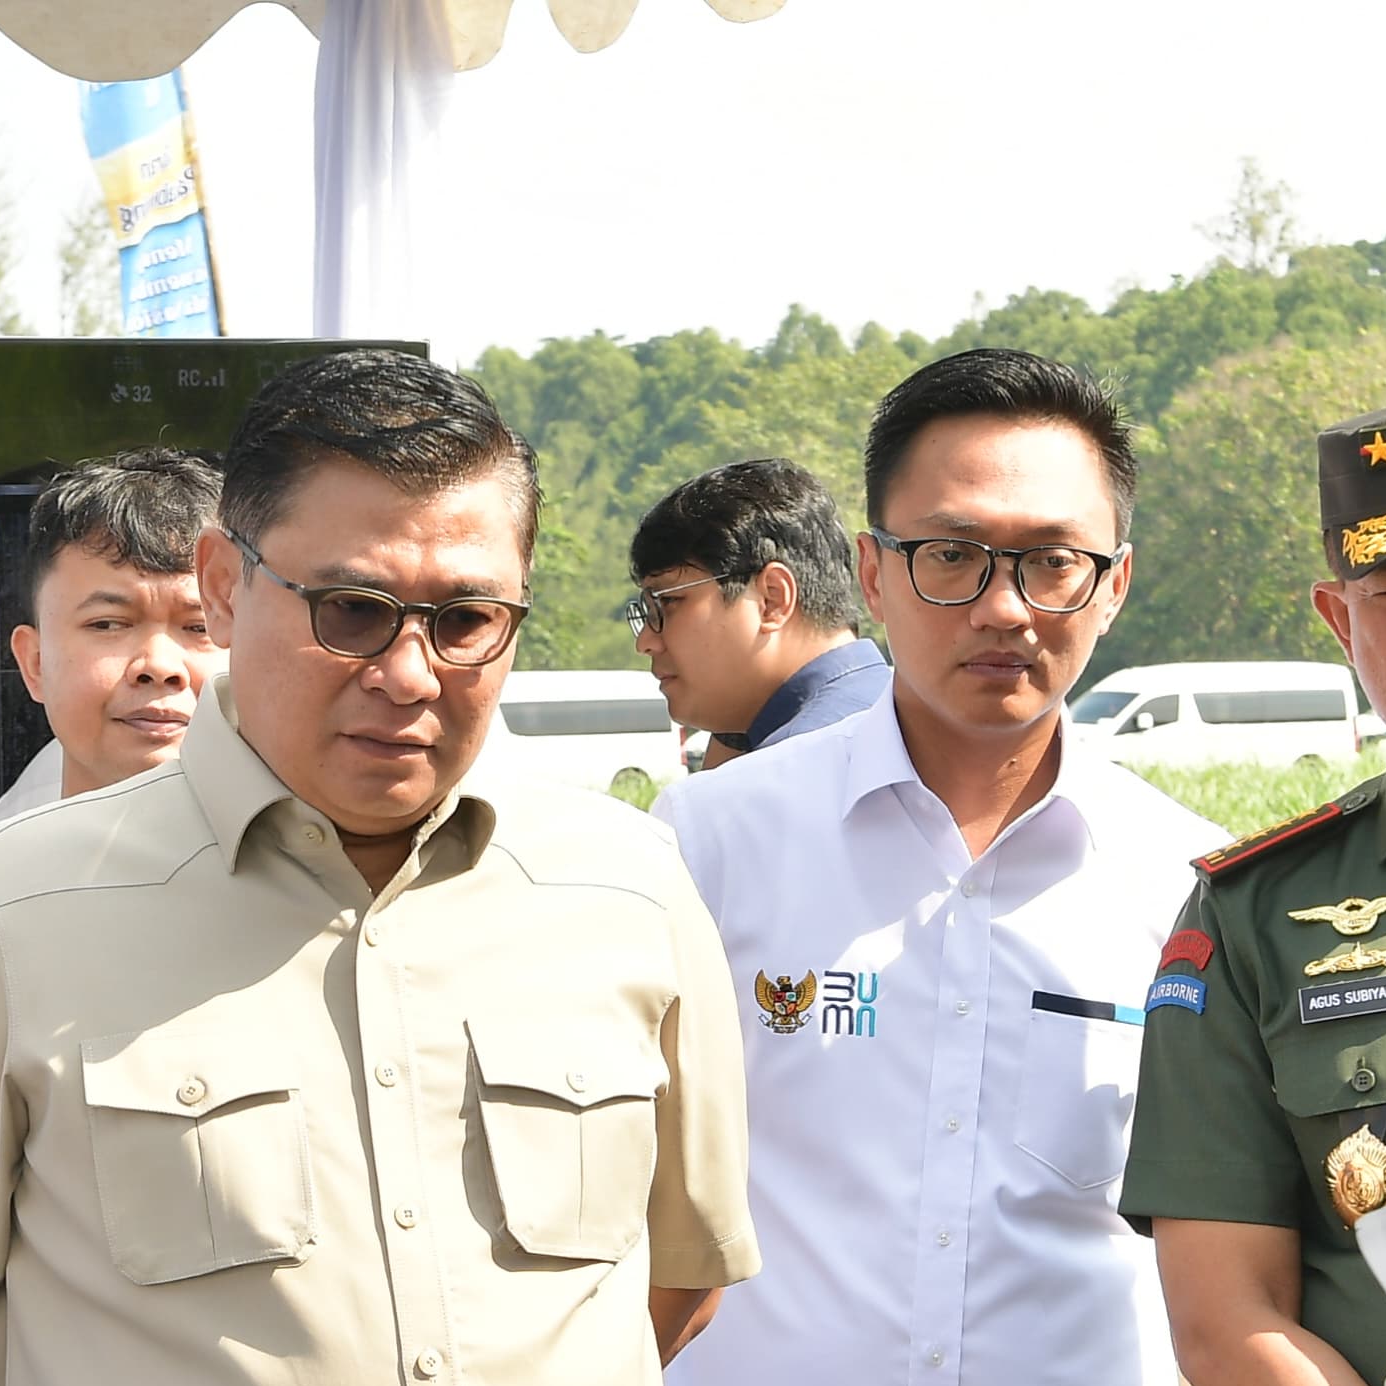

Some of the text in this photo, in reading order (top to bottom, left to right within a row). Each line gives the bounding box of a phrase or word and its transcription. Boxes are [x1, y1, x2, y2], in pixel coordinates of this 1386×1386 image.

[178, 369, 201, 387] RC
[132, 385, 152, 403] 32
[1148, 982, 1200, 1004] AIRBORNE
[1309, 993, 1341, 1011] AGUS
